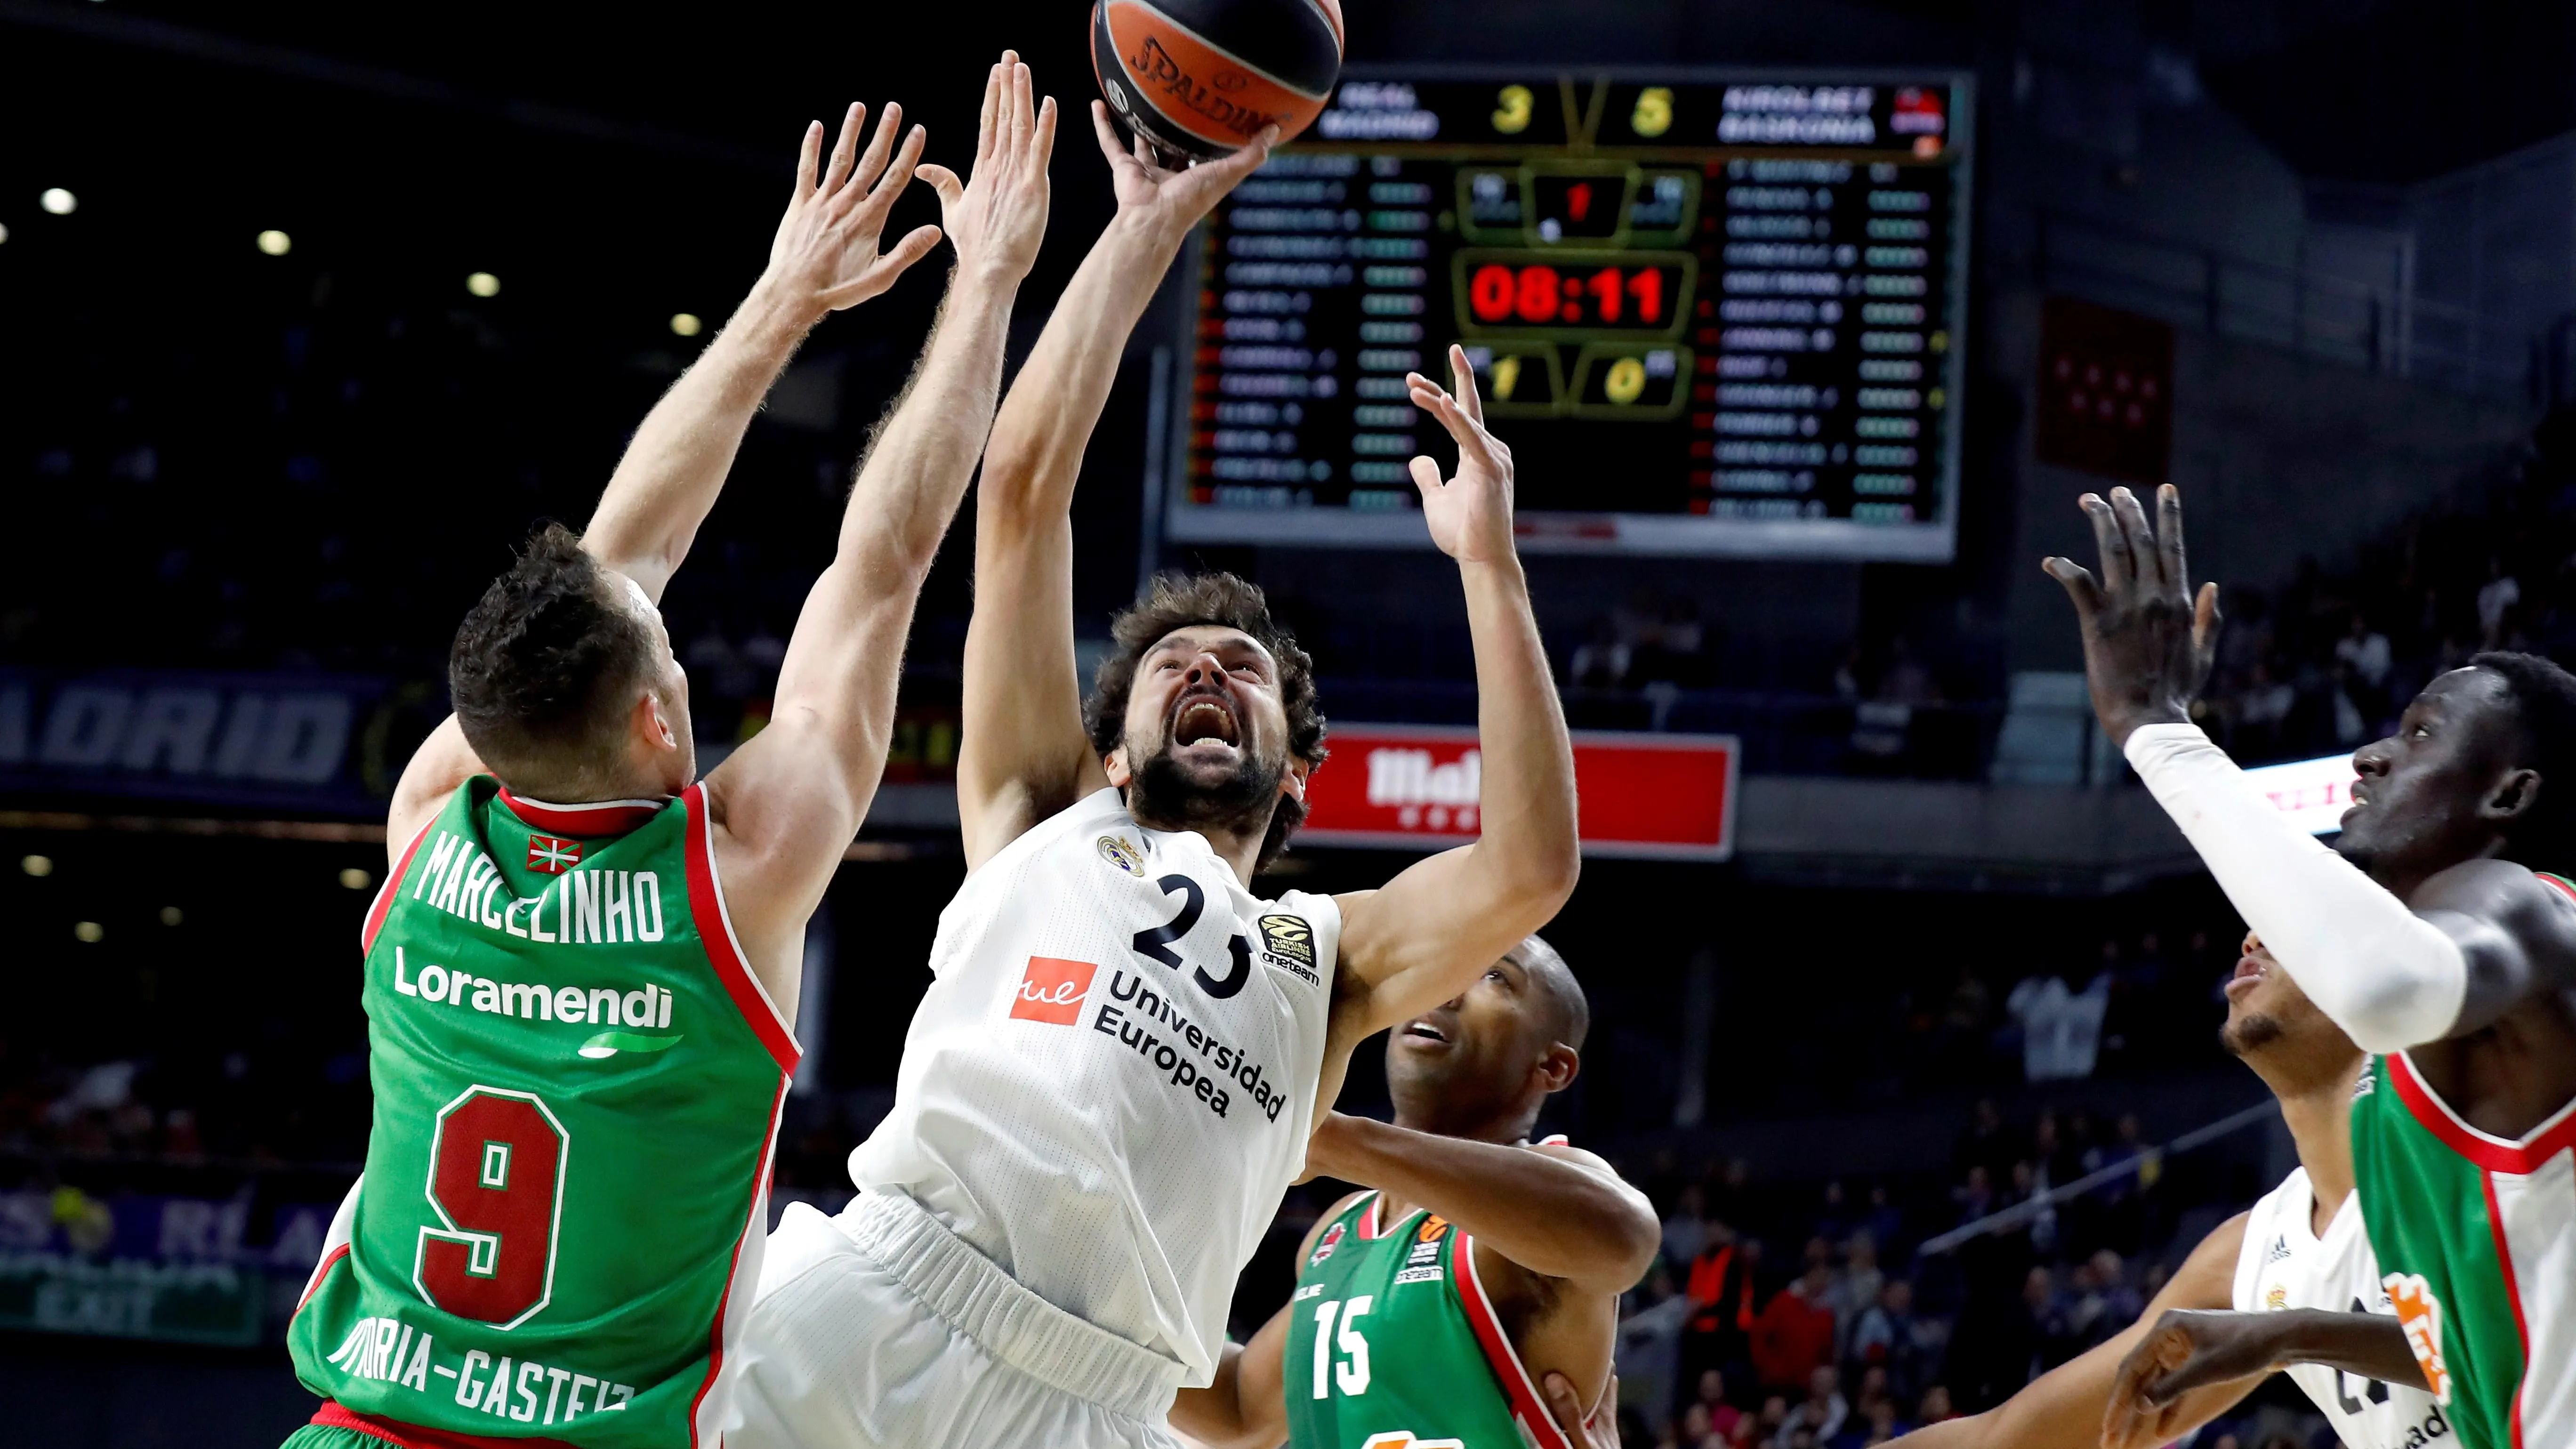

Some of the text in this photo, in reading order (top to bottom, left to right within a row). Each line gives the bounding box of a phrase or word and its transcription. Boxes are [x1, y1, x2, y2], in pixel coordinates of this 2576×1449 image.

[1131, 35, 1292, 137] SPALDIN
[1492, 85, 1534, 133] 3
[1631, 88, 1674, 137] 5
[1470, 264, 1662, 324] 08:11
[1605, 357, 1645, 403] 0
[413, 831, 664, 943] MARCELINHO
[1262, 952, 1319, 987] oneteam
[1269, 938, 1310, 950] TURKISH
[1271, 942, 1311, 957] AIRLINES
[394, 946, 673, 1028] Loramendi
[1094, 1005, 1231, 1119] Europea
[1111, 971, 1286, 1123] Universidad
[412, 1084, 570, 1331] 9
[1313, 1295, 1373, 1400] 15
